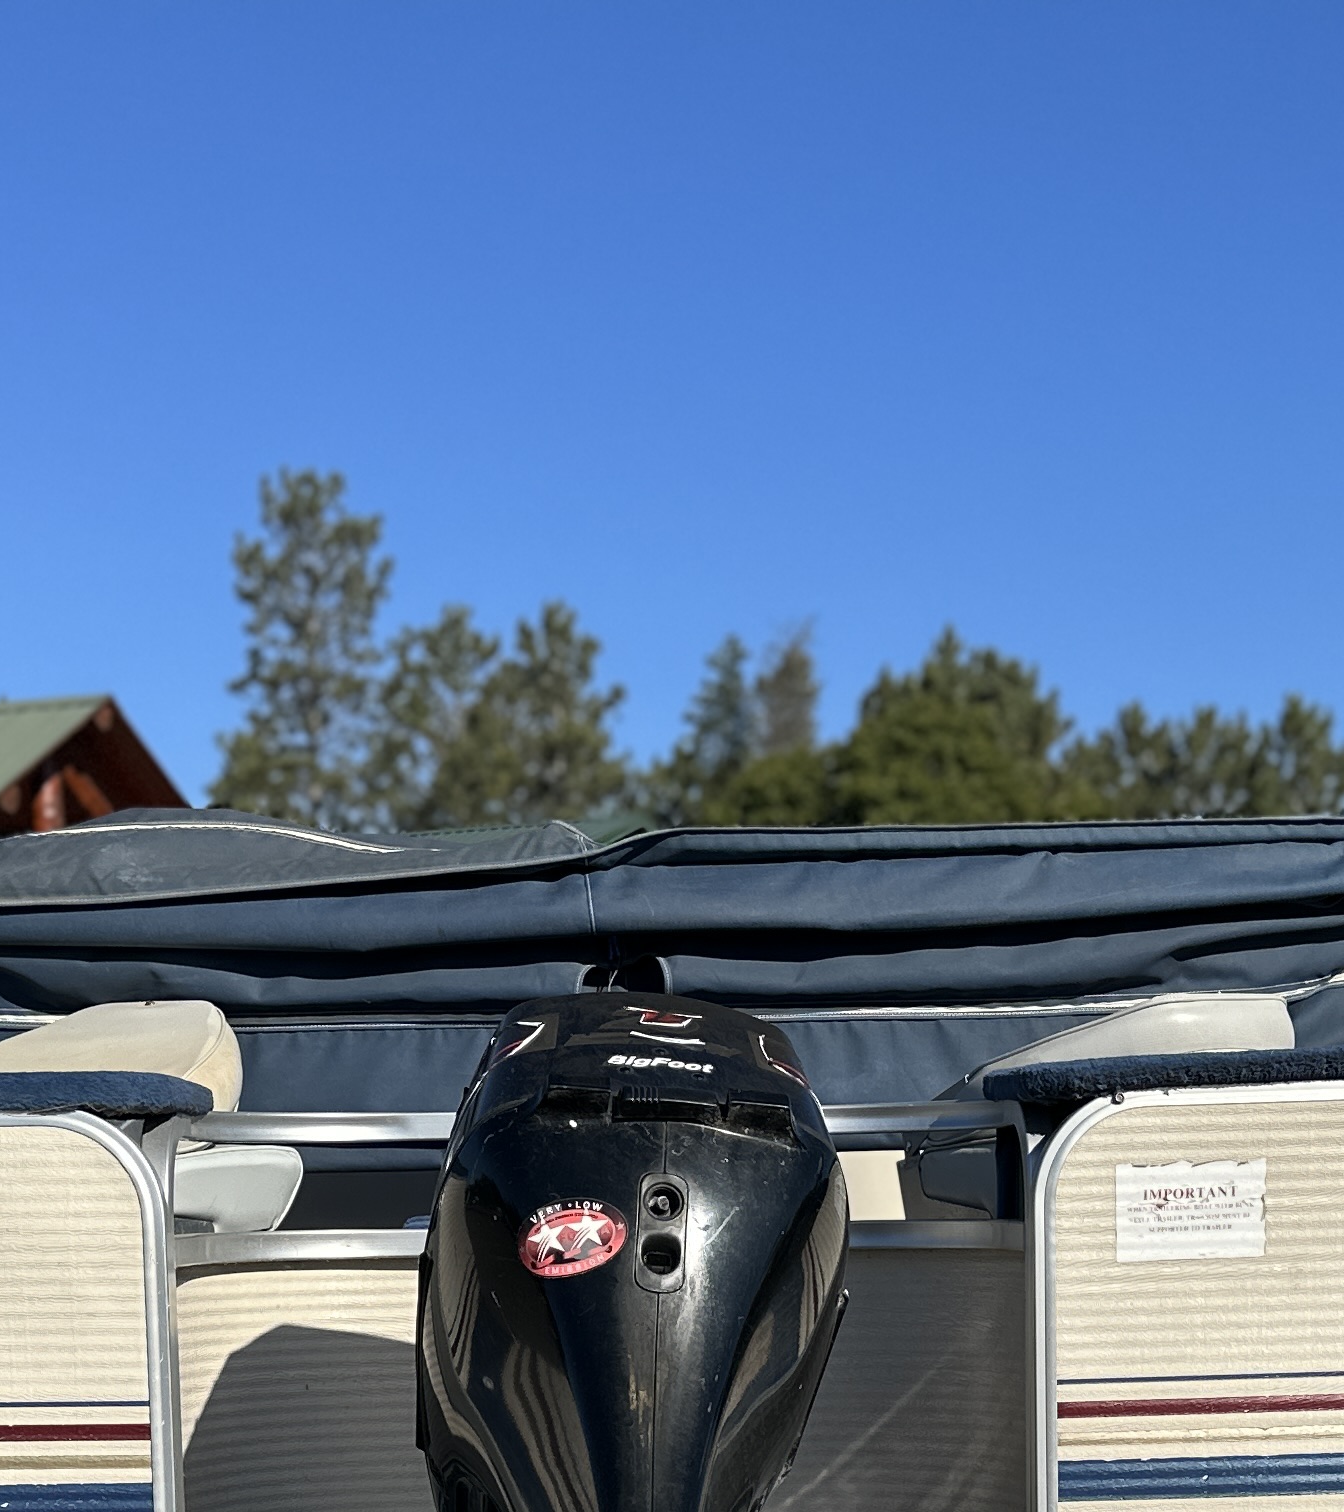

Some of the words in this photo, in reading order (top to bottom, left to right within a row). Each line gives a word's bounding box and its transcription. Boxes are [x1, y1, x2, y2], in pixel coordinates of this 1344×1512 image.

[1143, 1185, 1238, 1201] IMPORTANT
[529, 1203, 562, 1224] VERY
[575, 1200, 604, 1212] LOW
